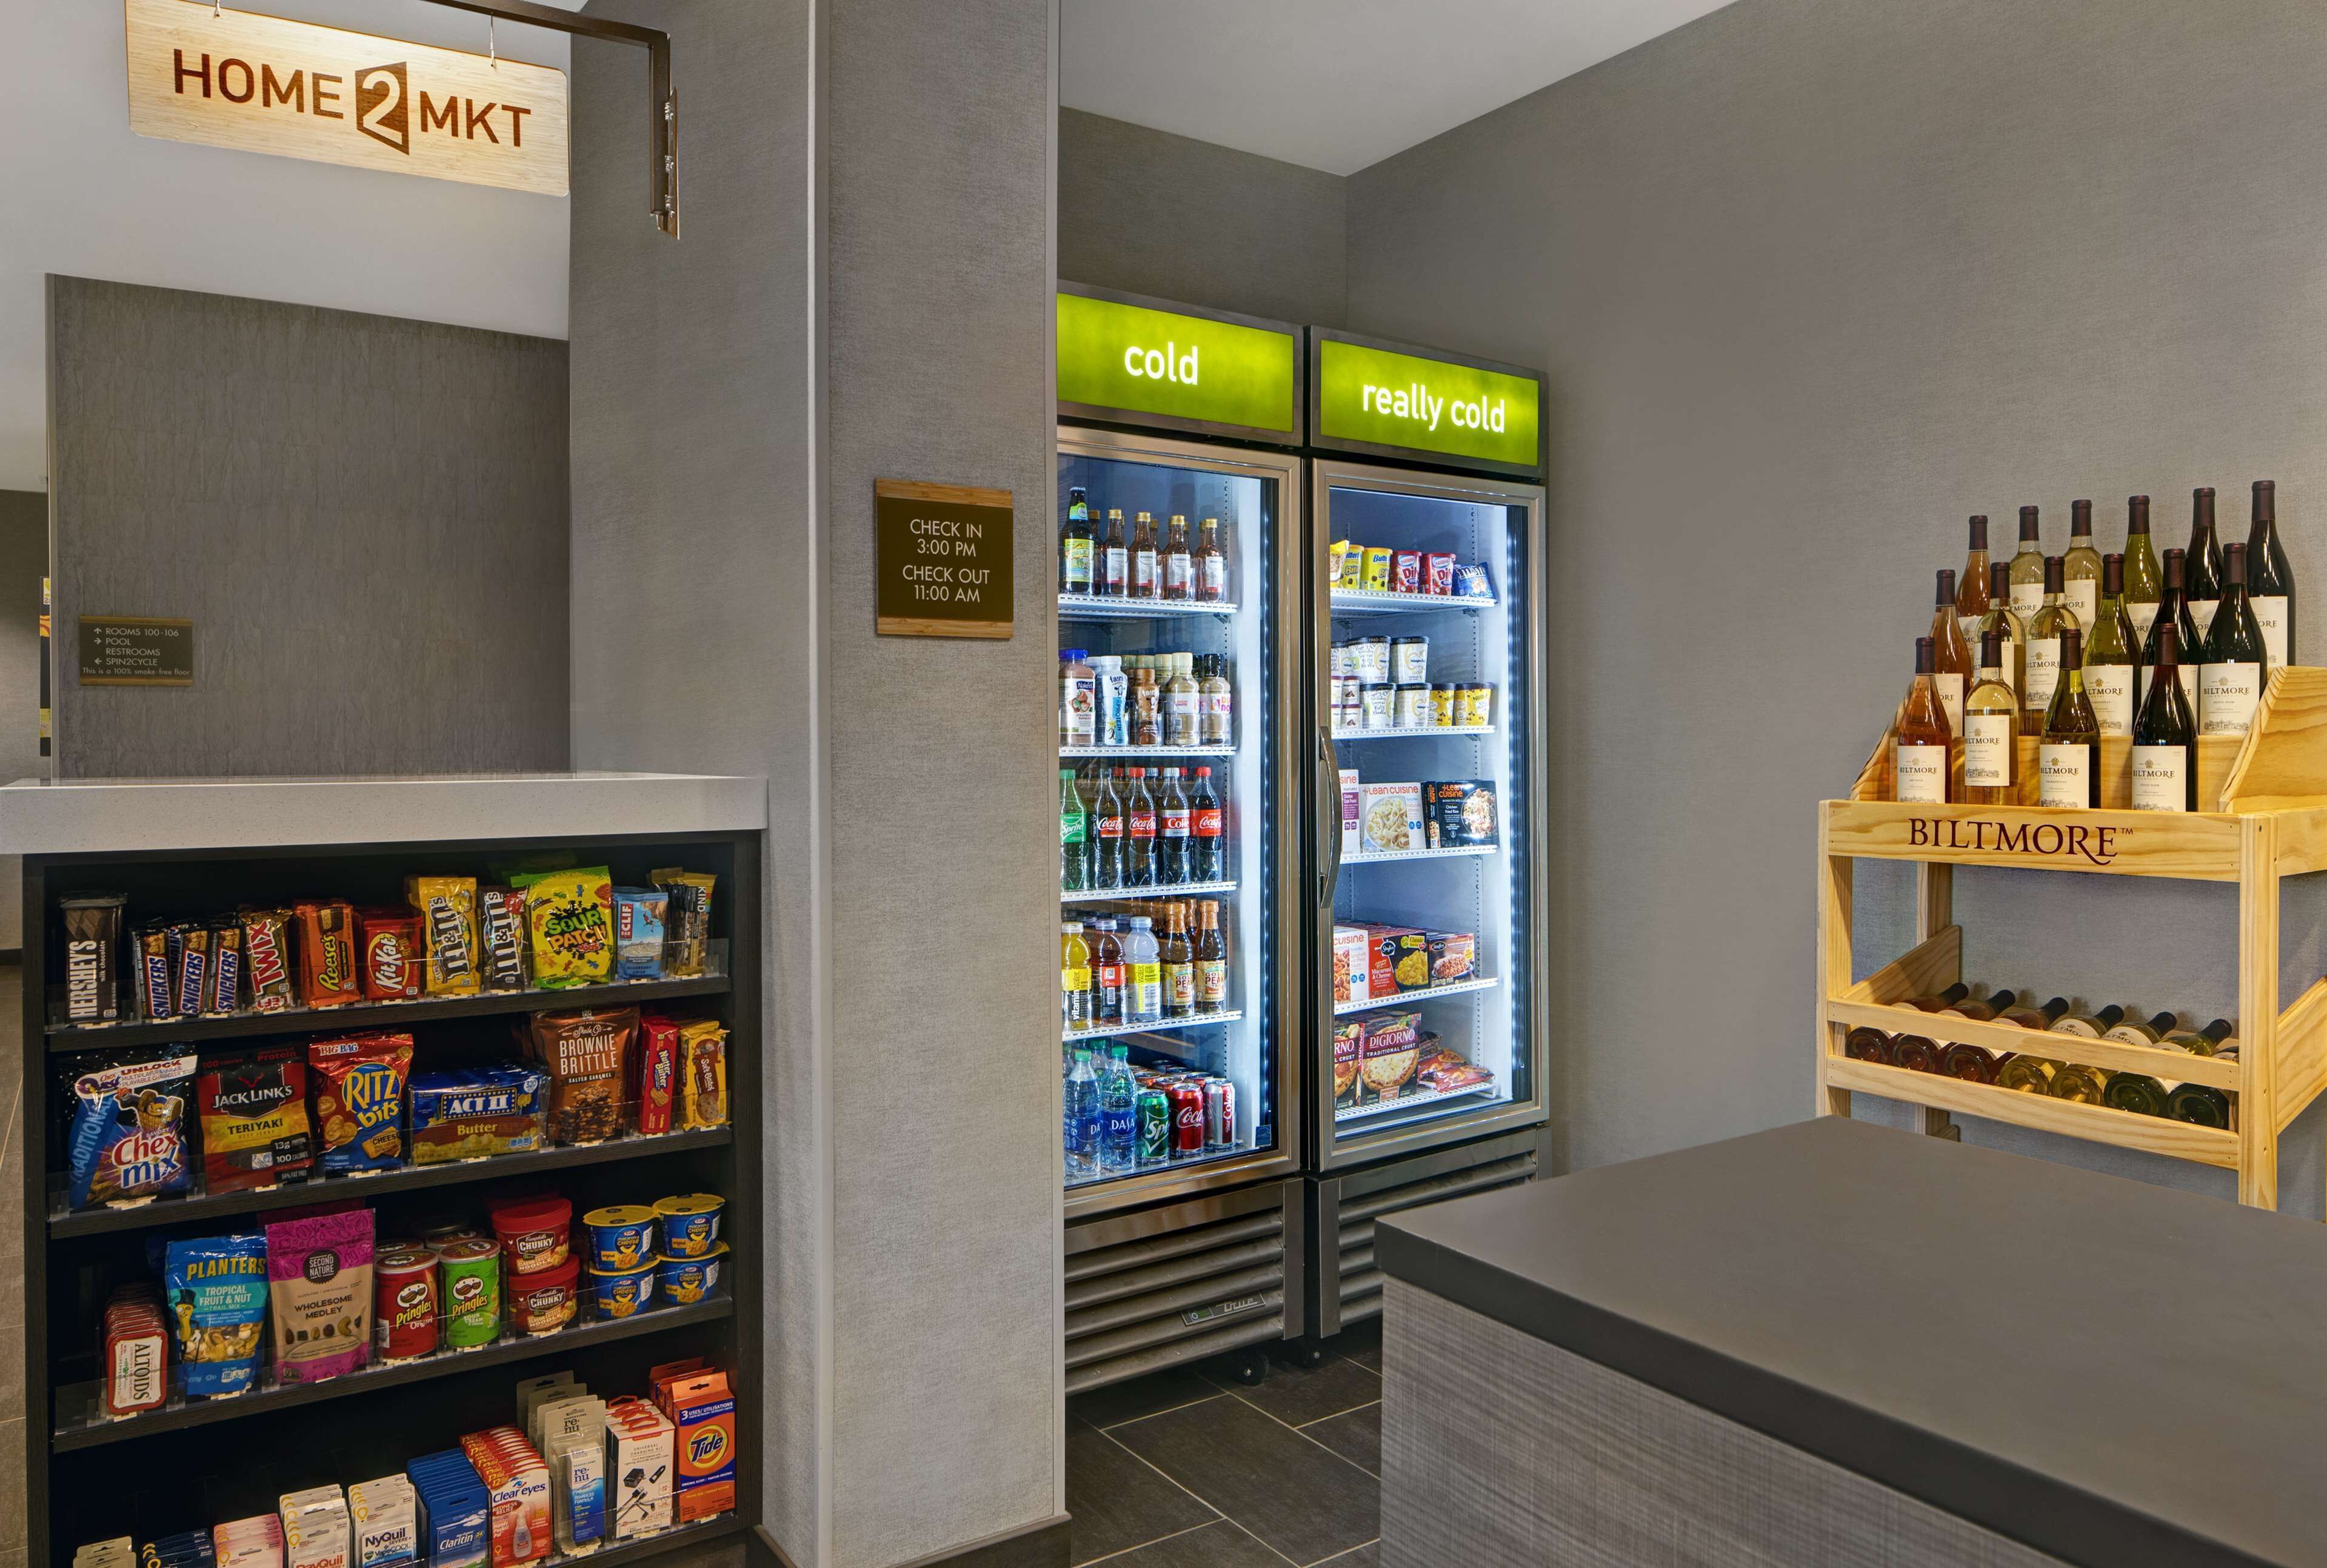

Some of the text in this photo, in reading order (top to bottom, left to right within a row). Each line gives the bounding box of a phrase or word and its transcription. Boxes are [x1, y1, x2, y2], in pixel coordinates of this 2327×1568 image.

[1124, 341, 1199, 386] cold
[1362, 382, 1506, 434] really cold
[910, 519, 982, 538] CHECK IN
[917, 539, 977, 557] 3:00 PM
[903, 565, 990, 584] CHECK OUT
[914, 585, 980, 602] 11:00 AM
[106, 647, 161, 656] RESTROOMS
[1340, 775, 1357, 784] sine
[1061, 822, 1082, 835] Sprite
[1167, 818, 1190, 829] Coke
[1908, 818, 2118, 866] BILTMORE
[698, 886, 706, 912] KIND
[546, 909, 602, 935] SOUR
[621, 906, 632, 931] CLIF
[549, 924, 607, 950] PATCH
[69, 940, 98, 1018] HERSHEY'S
[149, 956, 172, 1017] SNICKERS
[182, 952, 204, 1015] SNICKERS
[218, 950, 238, 1012] SNICKERS
[559, 1034, 616, 1057] BROWNIE
[1369, 1029, 1415, 1049] DIGIORNO
[257, 1051, 296, 1062] Protein
[319, 1043, 359, 1056] BIG BAG
[1367, 1047, 1400, 1056] TRADITIONAL
[121, 1059, 182, 1075] UNLOCK
[560, 1052, 618, 1075] BRITTLE
[659, 1050, 670, 1076] Nutter
[589, 1072, 612, 1081] CARAMEL
[655, 1064, 667, 1087] Butter
[213, 1086, 293, 1109] JACK LINK'S
[346, 1070, 398, 1113] RITZ
[358, 1100, 399, 1128] bits
[449, 1095, 509, 1115] ACT II
[1223, 1092, 1232, 1121] Coke
[227, 1118, 284, 1135] TERIYAKI
[457, 1123, 498, 1136] Butter
[114, 1133, 179, 1165] Chex
[274, 1141, 290, 1150] 13g
[123, 1147, 178, 1187] mix
[276, 1154, 292, 1163] 100
[519, 1237, 553, 1251] CHUNKY
[187, 1257, 266, 1281] PLANTERS
[309, 1254, 334, 1267] SECOND
[310, 1265, 334, 1277] NATURE
[199, 1295, 224, 1306] FRUIT
[234, 1293, 252, 1303] NUT
[205, 1285, 247, 1296] TROPICAL
[530, 1292, 564, 1307] CHUNKY
[295, 1294, 353, 1312] WHOLESOME
[452, 1294, 488, 1320] Pringles
[305, 1306, 343, 1320] MEDLEY
[396, 1300, 432, 1330] Pringles
[133, 1344, 150, 1400] ALTOIDS
[681, 1401, 733, 1420] 3 UTILISATIONS
[690, 1432, 724, 1463] Tide
[493, 1483, 546, 1504] Clear eyes
[492, 1501, 518, 1513] REDNESS
[496, 1507, 515, 1516] RELIEF
[366, 1527, 406, 1547] NyQuil
[389, 1536, 408, 1545] SEVERE
[439, 1535, 473, 1550] Claritin
